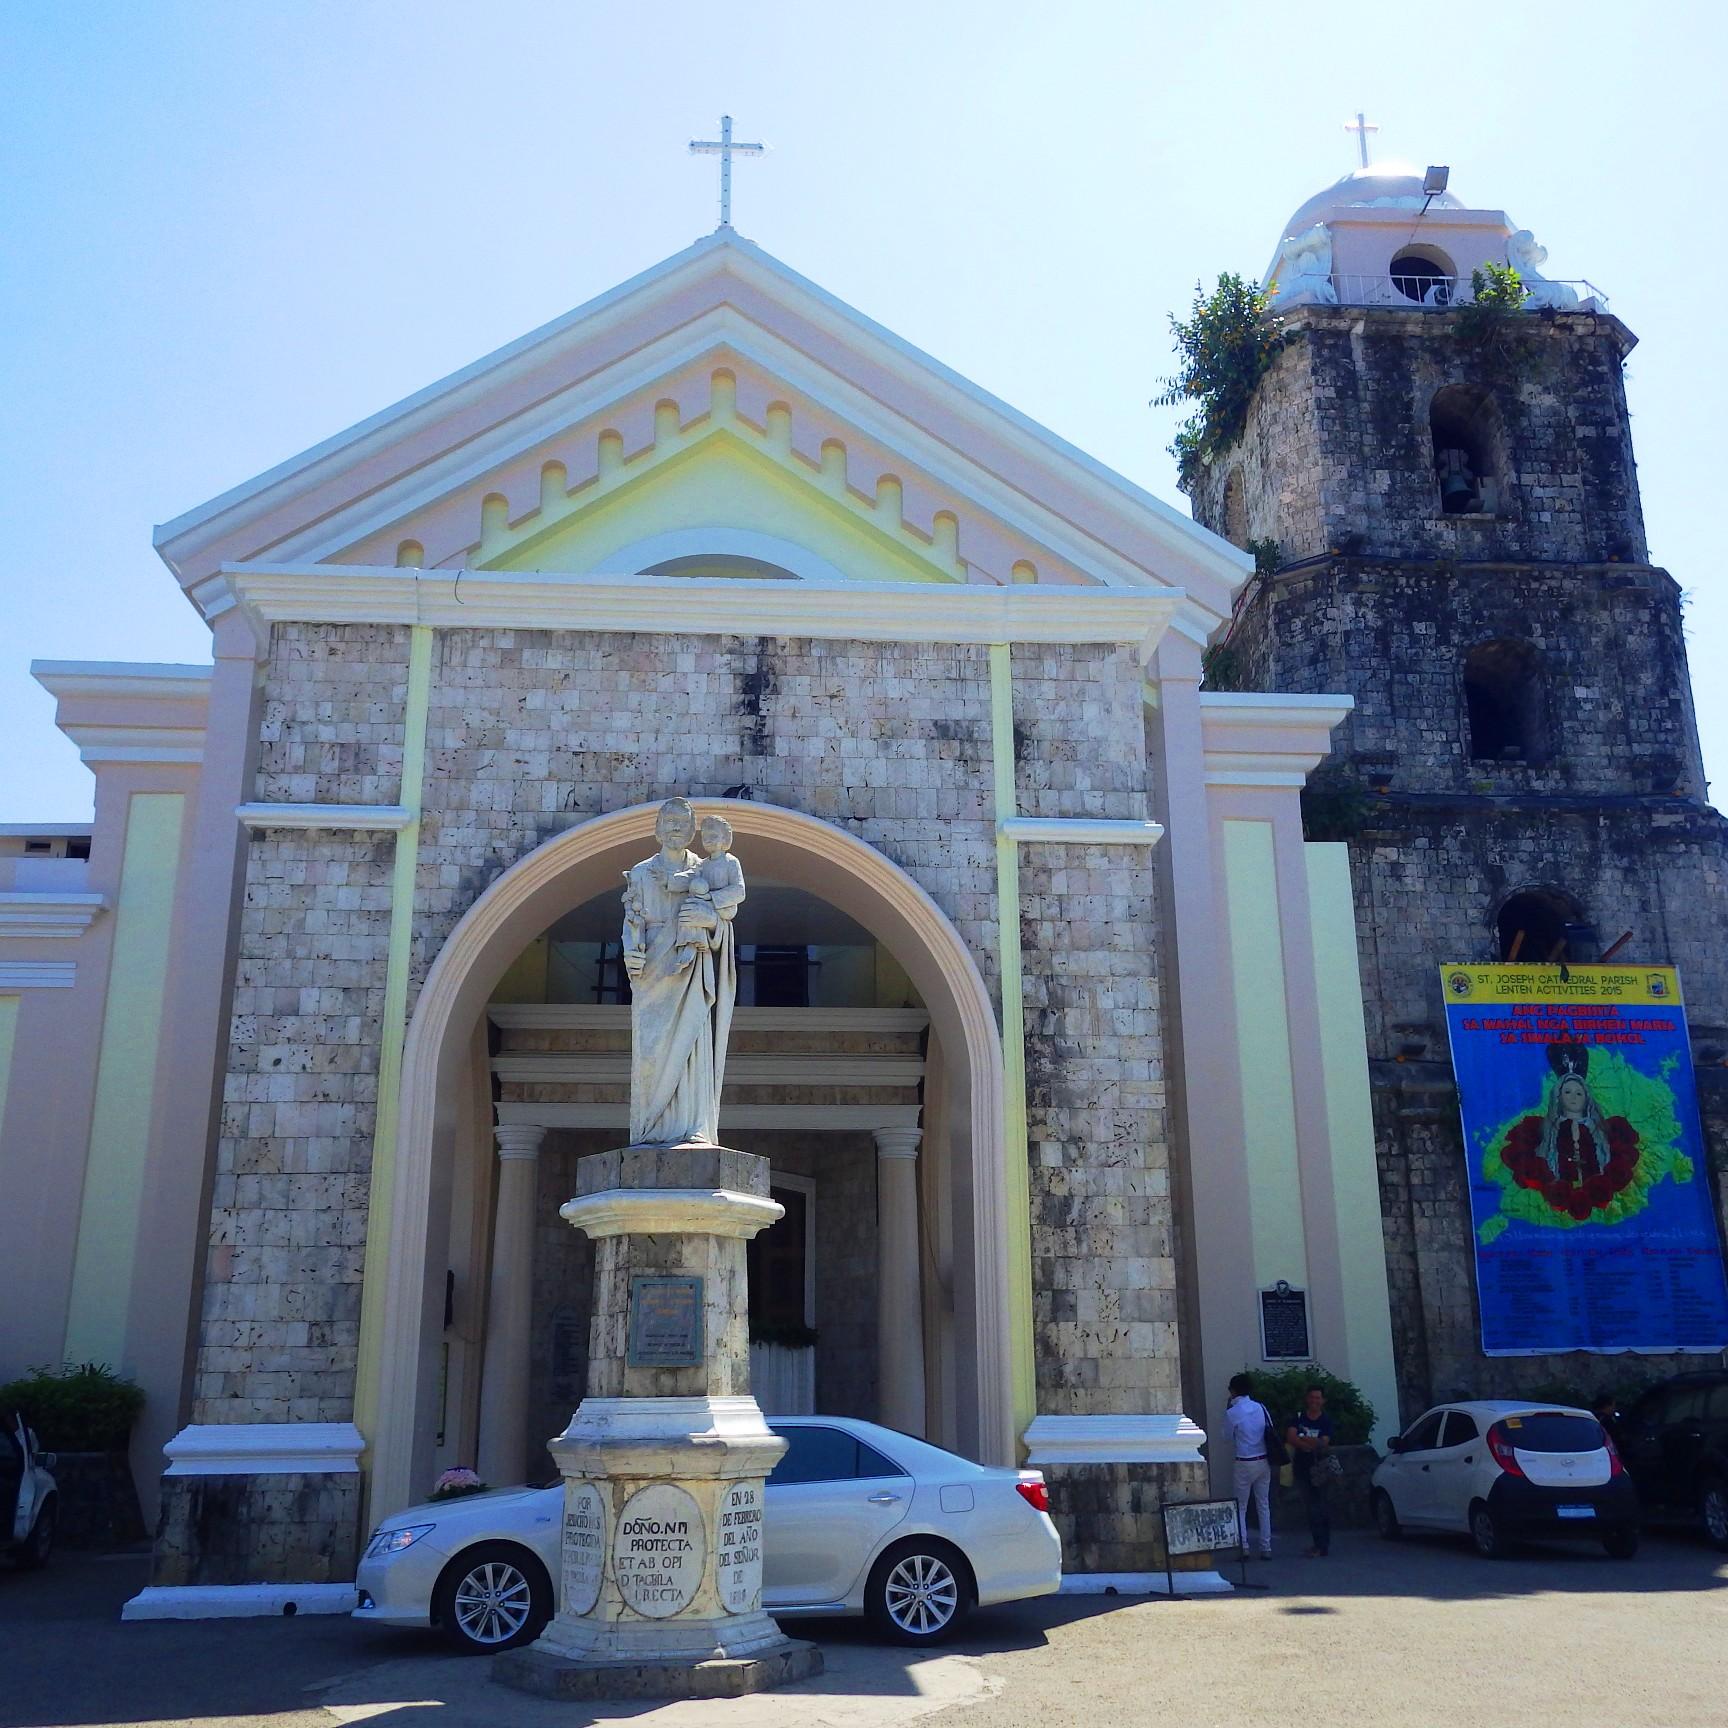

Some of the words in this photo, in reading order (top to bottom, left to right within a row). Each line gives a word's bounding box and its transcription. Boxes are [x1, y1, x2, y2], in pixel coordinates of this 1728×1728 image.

[1477, 974, 1493, 985] ST.
[1496, 974, 1534, 985] JOSEPH
[1601, 975, 1639, 986] PARISH
[1495, 984, 1533, 995] LENTEN
[1536, 985, 1597, 996] ACTIVITIES
[1600, 985, 1623, 996] 2015
[731, 1491, 742, 1506] EN
[744, 1490, 755, 1505] 28
[722, 1513, 733, 1527] DE
[723, 1531, 736, 1546] DEL
[739, 1526, 758, 1544] AÑO
[630, 1538, 693, 1552] PROTECTA
[618, 1556, 635, 1570] ET
[637, 1556, 656, 1569] AB
[662, 1556, 683, 1569] OPI
[719, 1551, 731, 1568] DEL
[733, 1546, 760, 1565] SEÑOR
